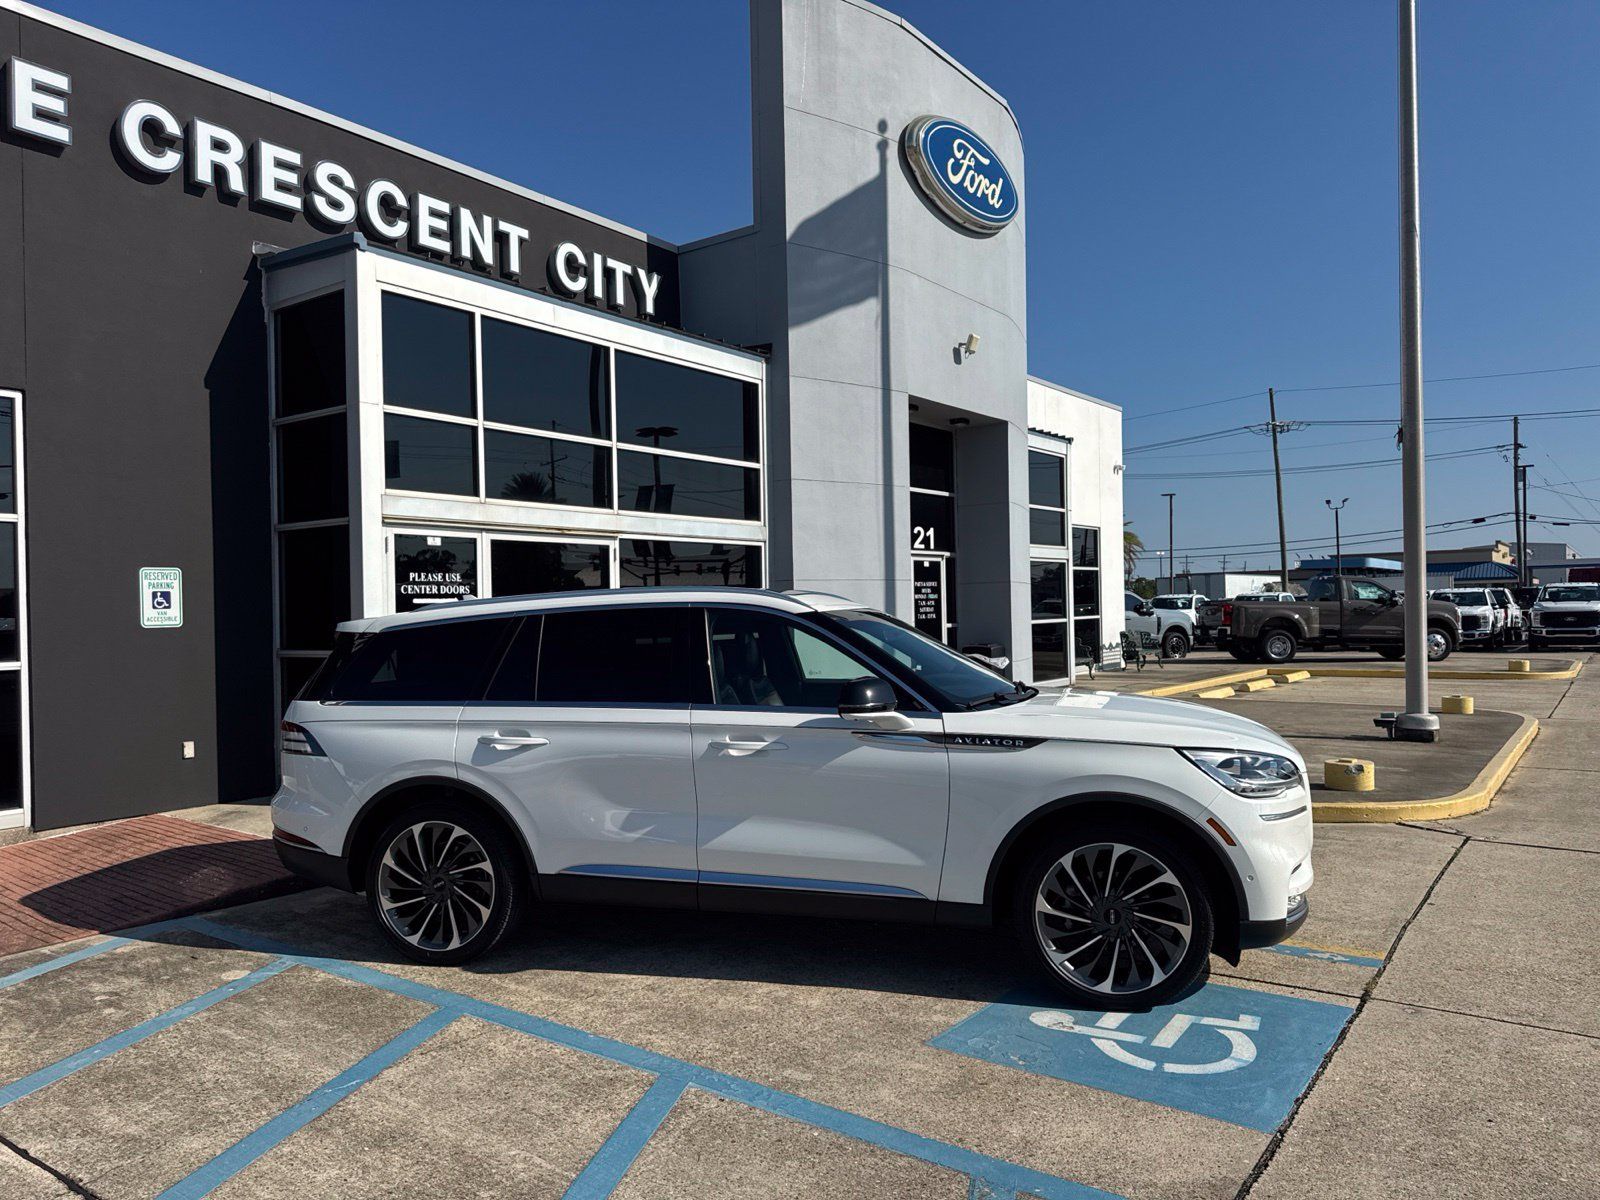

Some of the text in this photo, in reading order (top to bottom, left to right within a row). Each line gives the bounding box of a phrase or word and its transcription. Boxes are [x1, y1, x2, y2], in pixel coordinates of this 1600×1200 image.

[946, 138, 1004, 209] Ford
[11, 56, 661, 316] E CRESCENT CITY
[913, 526, 935, 550] 21
[143, 571, 178, 581] RESERVED
[409, 572, 463, 582] PLEASE USE
[147, 581, 175, 590] PARKING
[400, 584, 471, 595] CENTER DOORS
[954, 736, 1025, 747] AVIATOR
